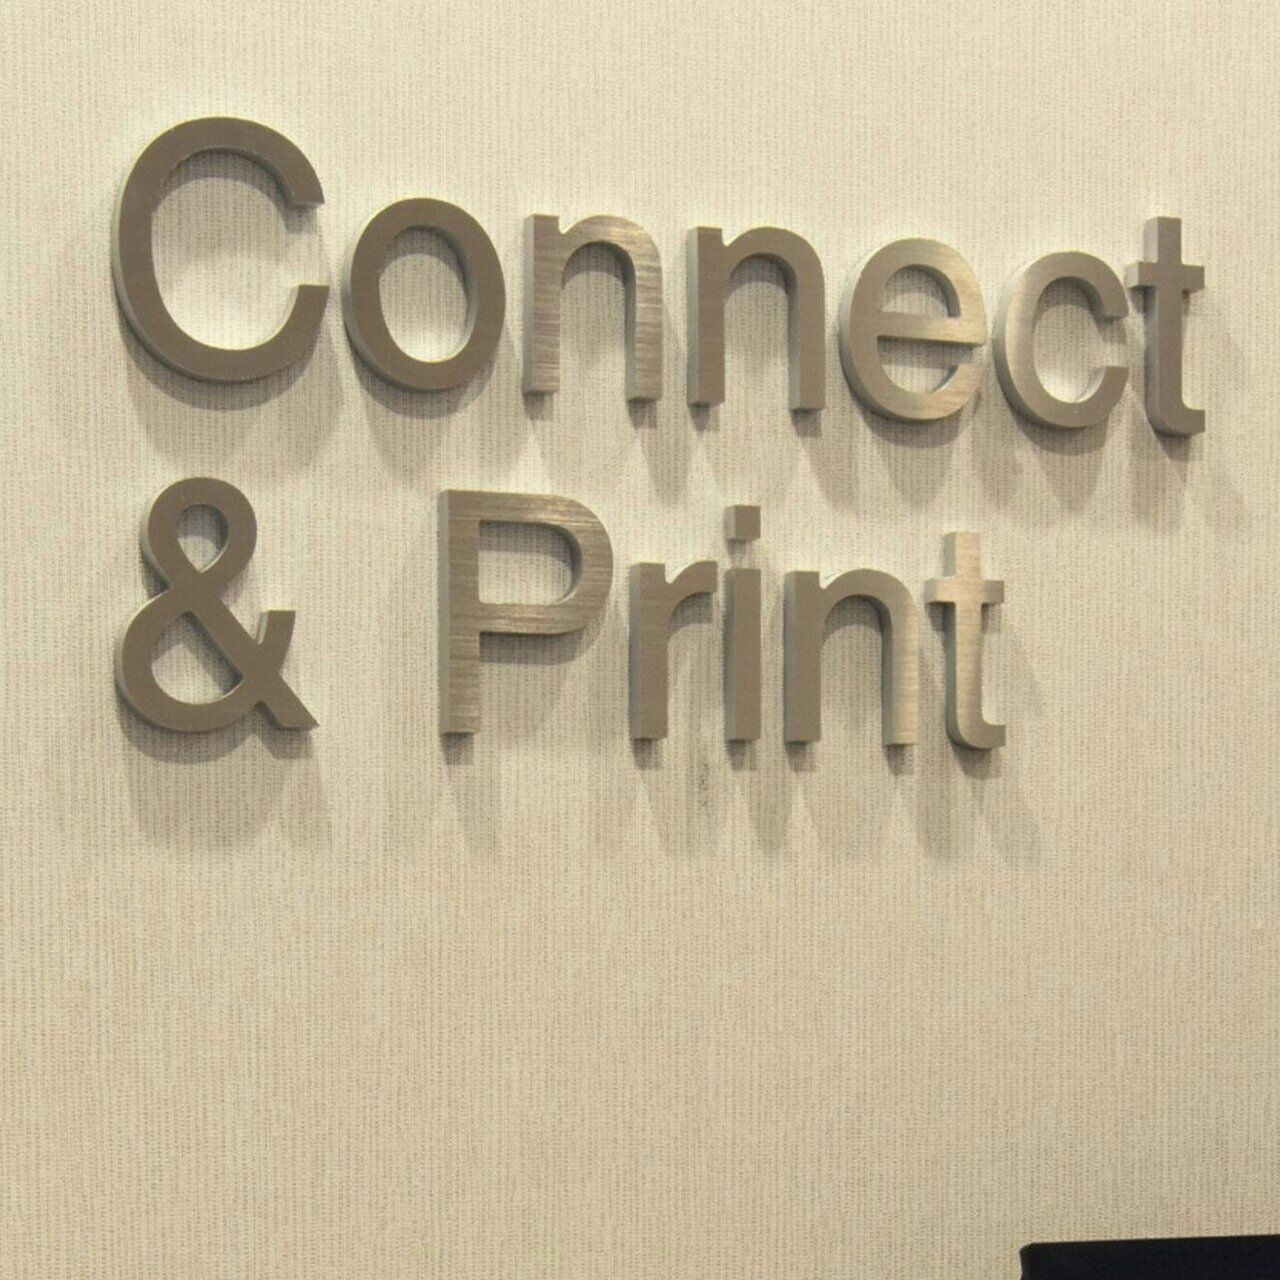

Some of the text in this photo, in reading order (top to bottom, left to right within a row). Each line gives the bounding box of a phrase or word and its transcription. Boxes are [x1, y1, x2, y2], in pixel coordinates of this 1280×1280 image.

[111, 116, 1205, 438] Connect
[115, 475, 1006, 750] & Print
